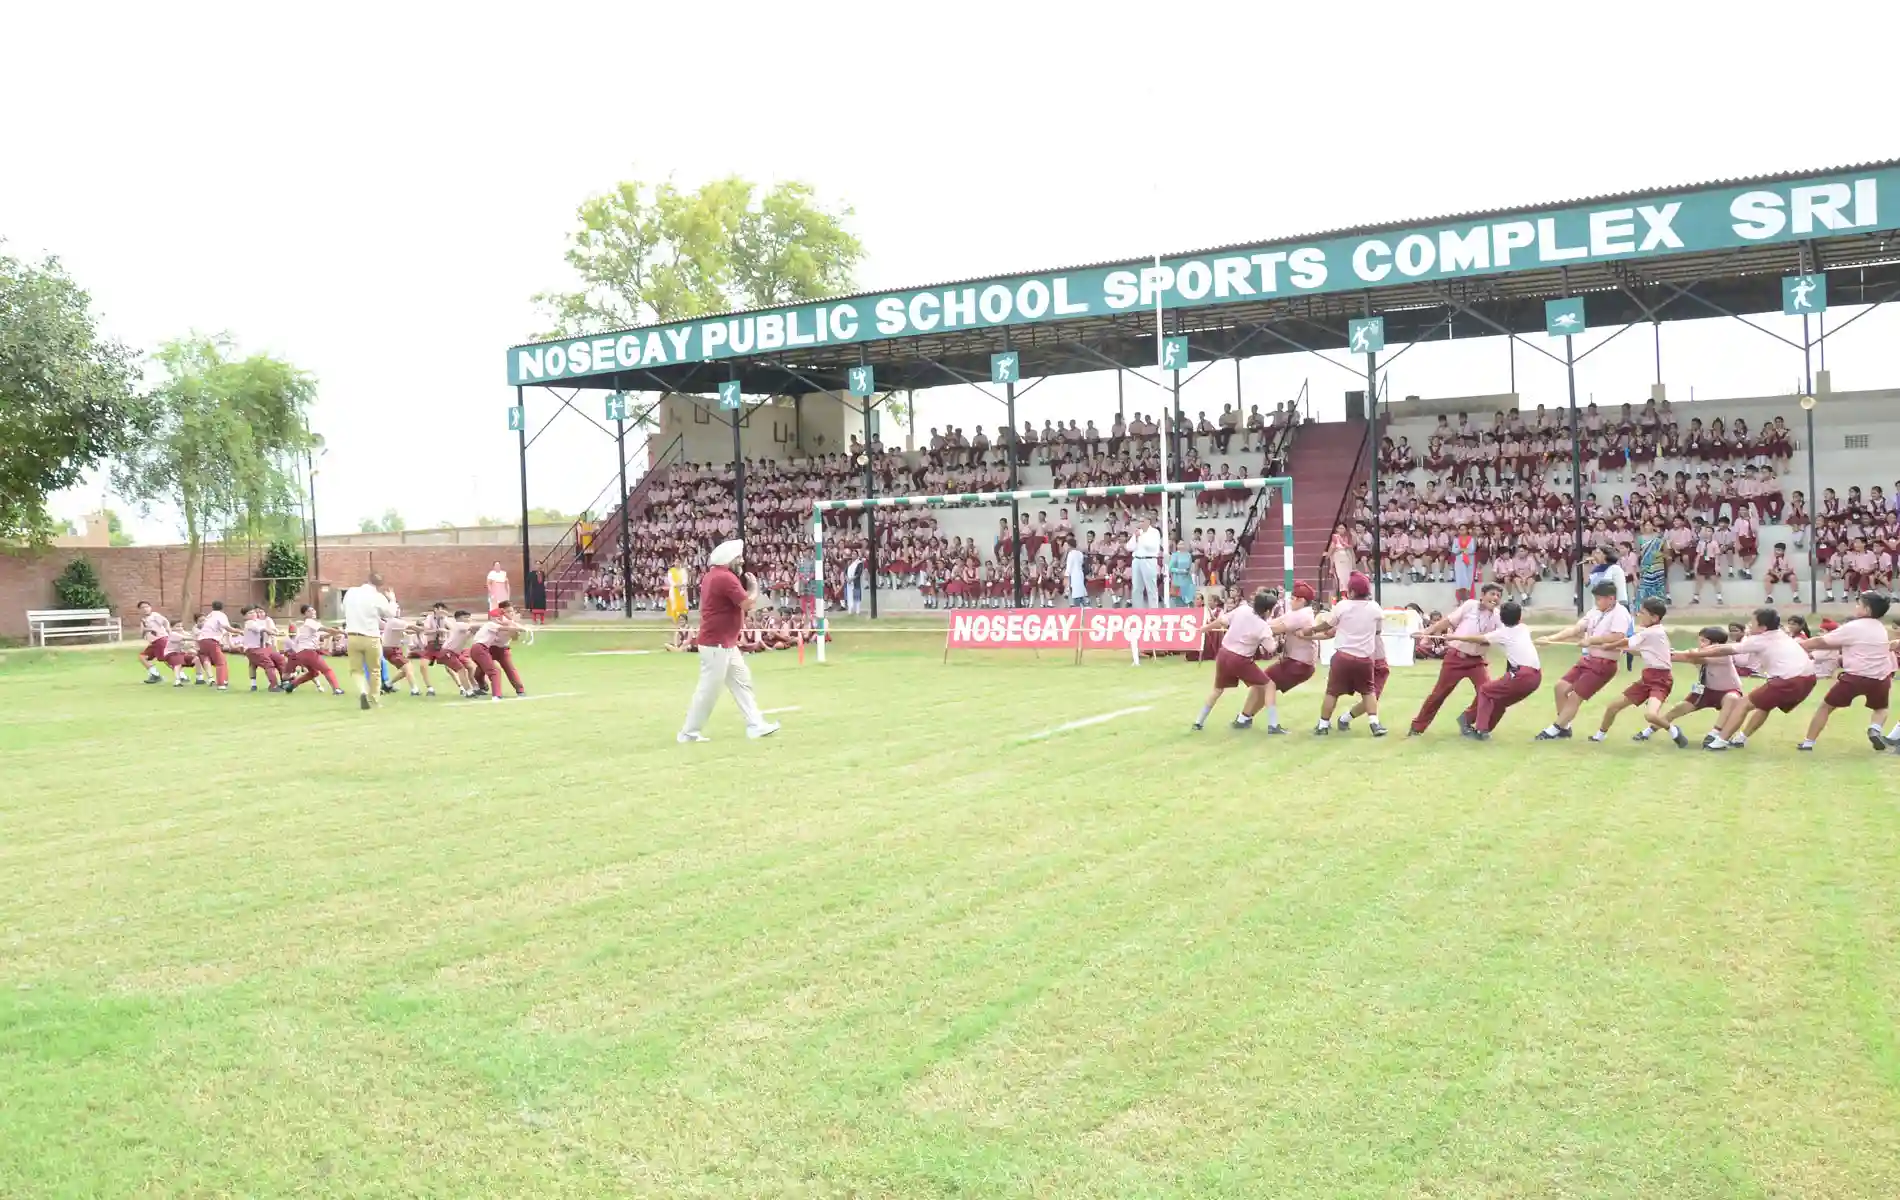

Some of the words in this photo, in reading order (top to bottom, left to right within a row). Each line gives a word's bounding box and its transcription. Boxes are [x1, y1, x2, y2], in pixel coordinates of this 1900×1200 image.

[518, 327, 691, 379] NOSEGAY
[703, 305, 857, 355] PUBLIC
[877, 278, 1087, 333] SCHOOL
[1104, 248, 1327, 309] SPORTS
[1353, 203, 1684, 281] COMPLEX
[1731, 178, 1876, 239] SRI
[954, 615, 1076, 641] NOSEGAY
[1089, 615, 1197, 642] SPORTS
